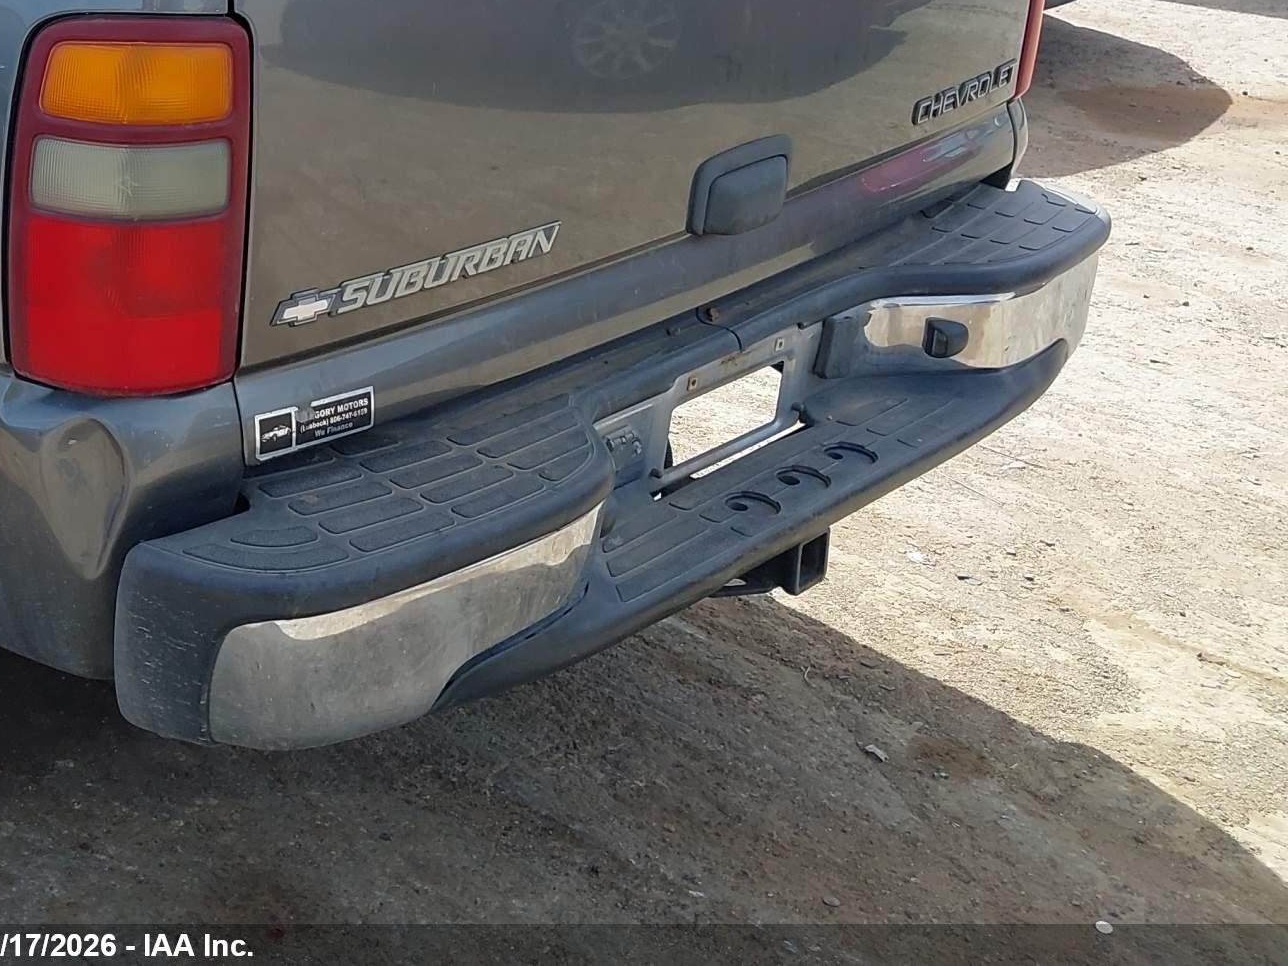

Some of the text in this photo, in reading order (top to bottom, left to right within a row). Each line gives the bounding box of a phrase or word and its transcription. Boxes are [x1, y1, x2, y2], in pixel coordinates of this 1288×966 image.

[912, 58, 1018, 125] CHEVROLET
[334, 220, 562, 315] SUBURBAN
[337, 398, 369, 413] MOTORS
[326, 422, 354, 434] Finance
